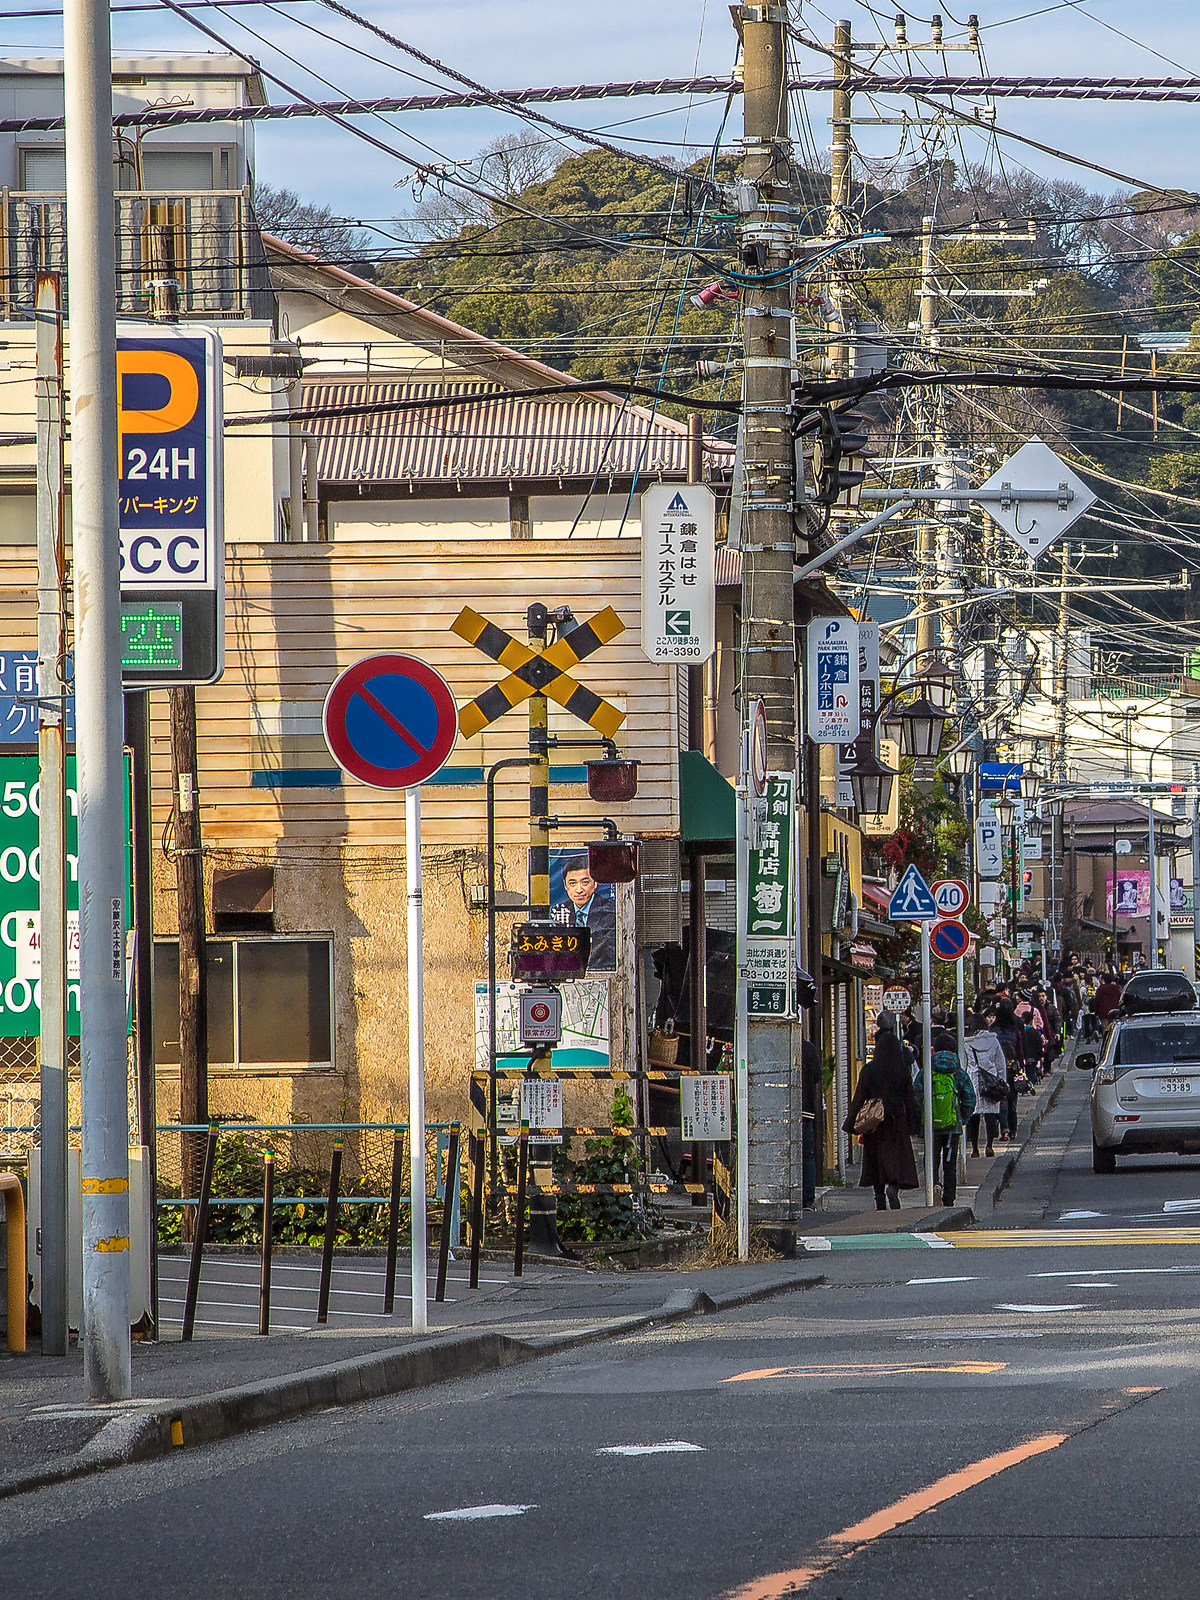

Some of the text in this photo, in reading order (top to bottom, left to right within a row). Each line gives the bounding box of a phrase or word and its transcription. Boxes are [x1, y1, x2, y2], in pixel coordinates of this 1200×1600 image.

[127, 447, 196, 480] 24H
[118, 496, 199, 515] パーキング
[680, 522, 698, 585] 鎌倉はせ
[121, 608, 181, 665] 空
[655, 647, 701, 656] 24-3390
[833, 654, 848, 681] 鎌倉
[819, 655, 833, 709] パークホテル
[772, 782, 788, 816] 刀剣
[838, 792, 850, 801] TEL
[982, 829, 996, 843] P
[758, 821, 781, 876] 専門店
[752, 881, 785, 932] 菊一
[939, 888, 960, 906] 40
[519, 935, 578, 952] ふみきり
[747, 970, 787, 980] 23-0122
[752, 1001, 780, 1010] 2-16
[524, 1029, 556, 1037] 非常ボタン
